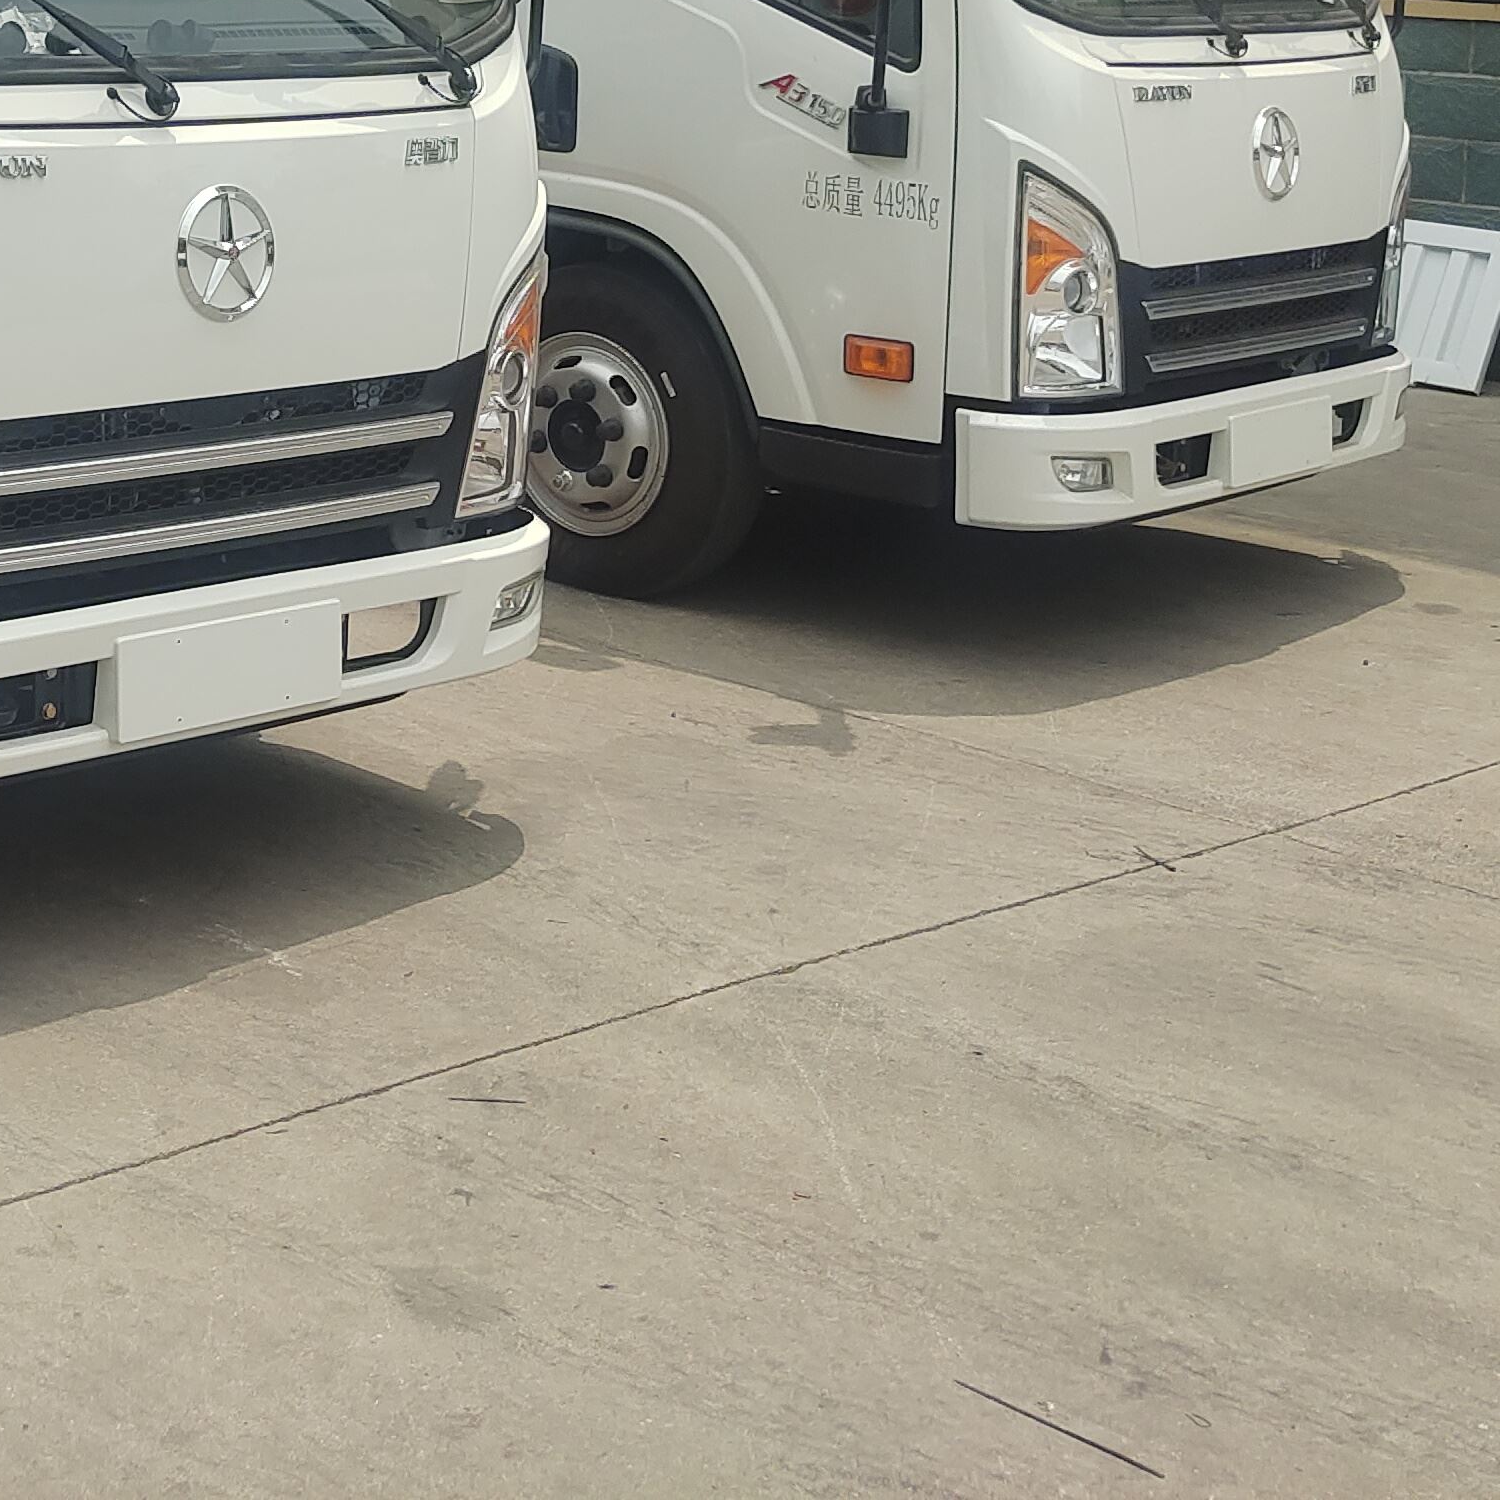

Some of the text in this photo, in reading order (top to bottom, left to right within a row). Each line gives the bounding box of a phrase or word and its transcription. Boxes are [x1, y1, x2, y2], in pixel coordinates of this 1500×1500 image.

[802, 170, 940, 231] 总质量 4495Kg
